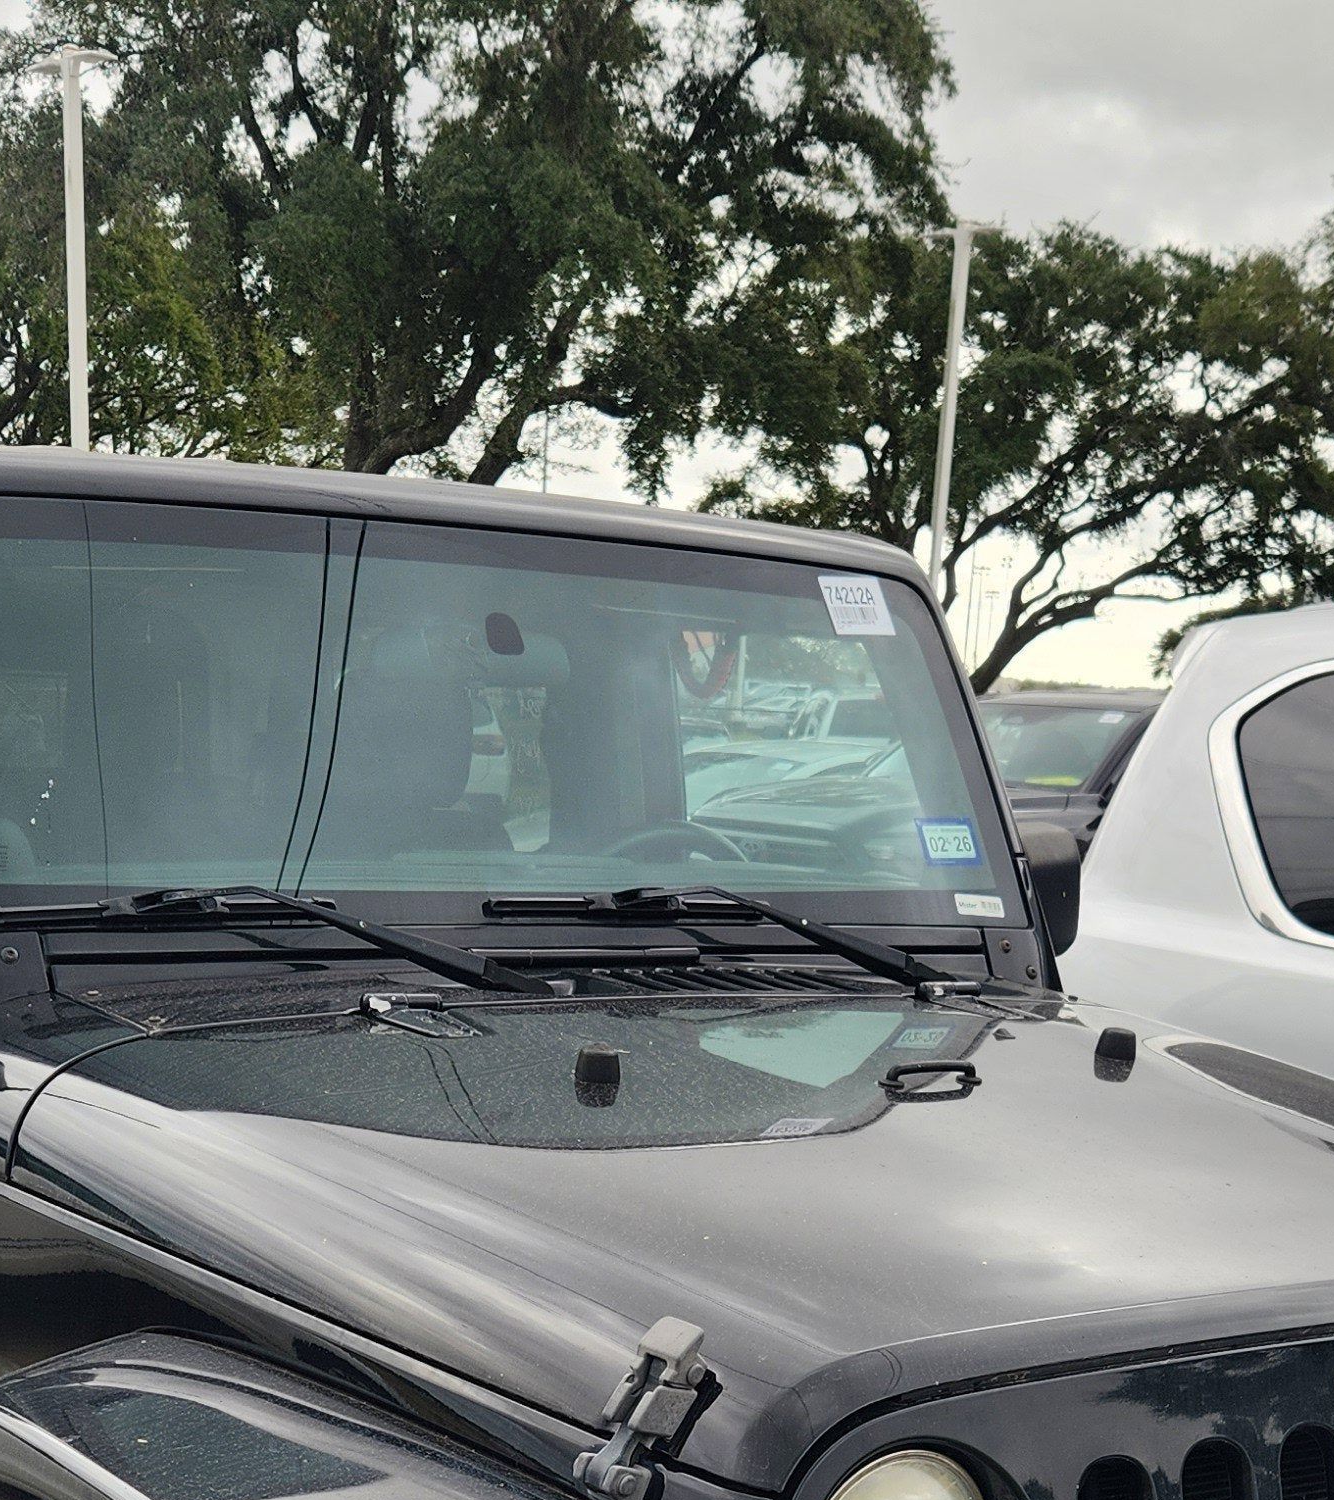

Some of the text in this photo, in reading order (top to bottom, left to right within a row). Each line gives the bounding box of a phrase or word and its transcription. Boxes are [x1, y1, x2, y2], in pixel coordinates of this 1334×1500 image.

[824, 586, 876, 605] 74212A
[929, 836, 972, 852] 02 26
